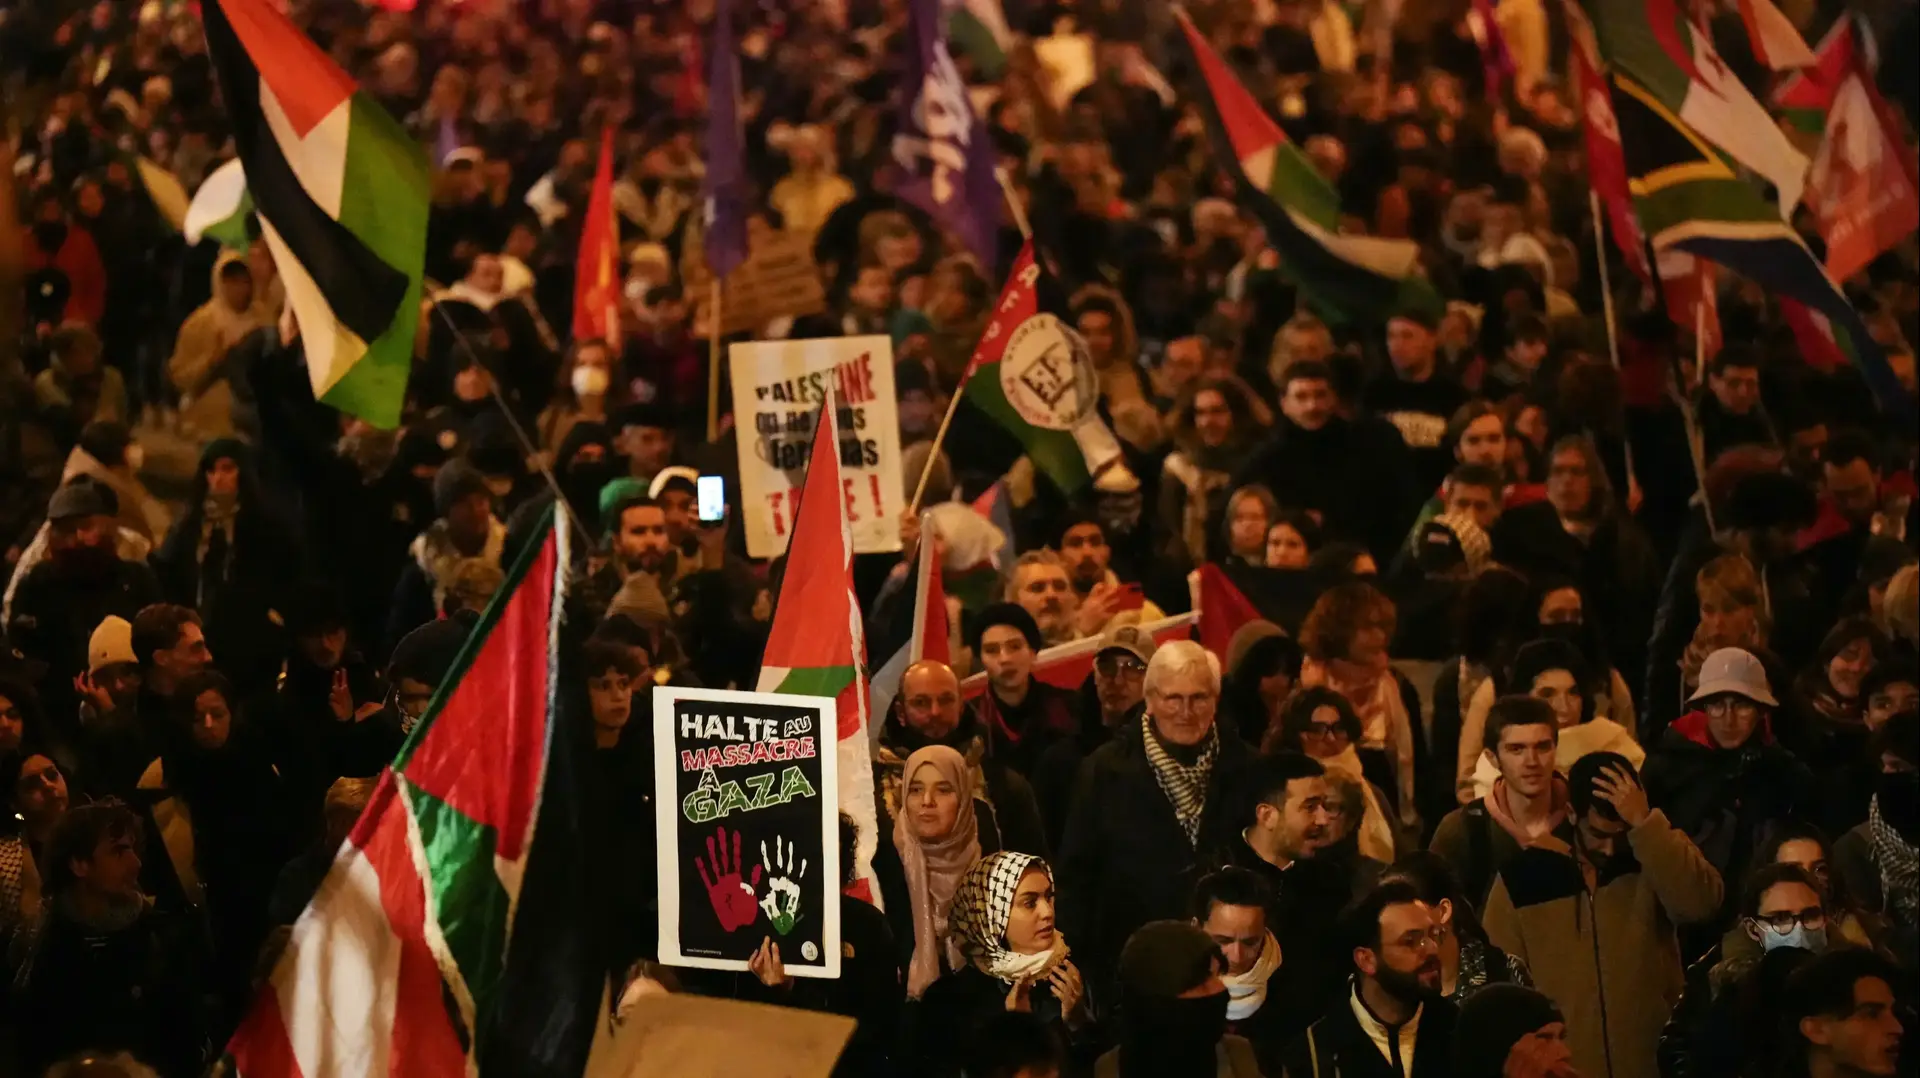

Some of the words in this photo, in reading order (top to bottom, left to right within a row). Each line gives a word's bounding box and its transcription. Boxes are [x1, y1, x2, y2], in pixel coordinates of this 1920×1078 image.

[680, 713, 780, 743] HALTE
[784, 715, 812, 737] AU
[681, 737, 816, 772] MASSACRE
[683, 766, 816, 823] GAZA
